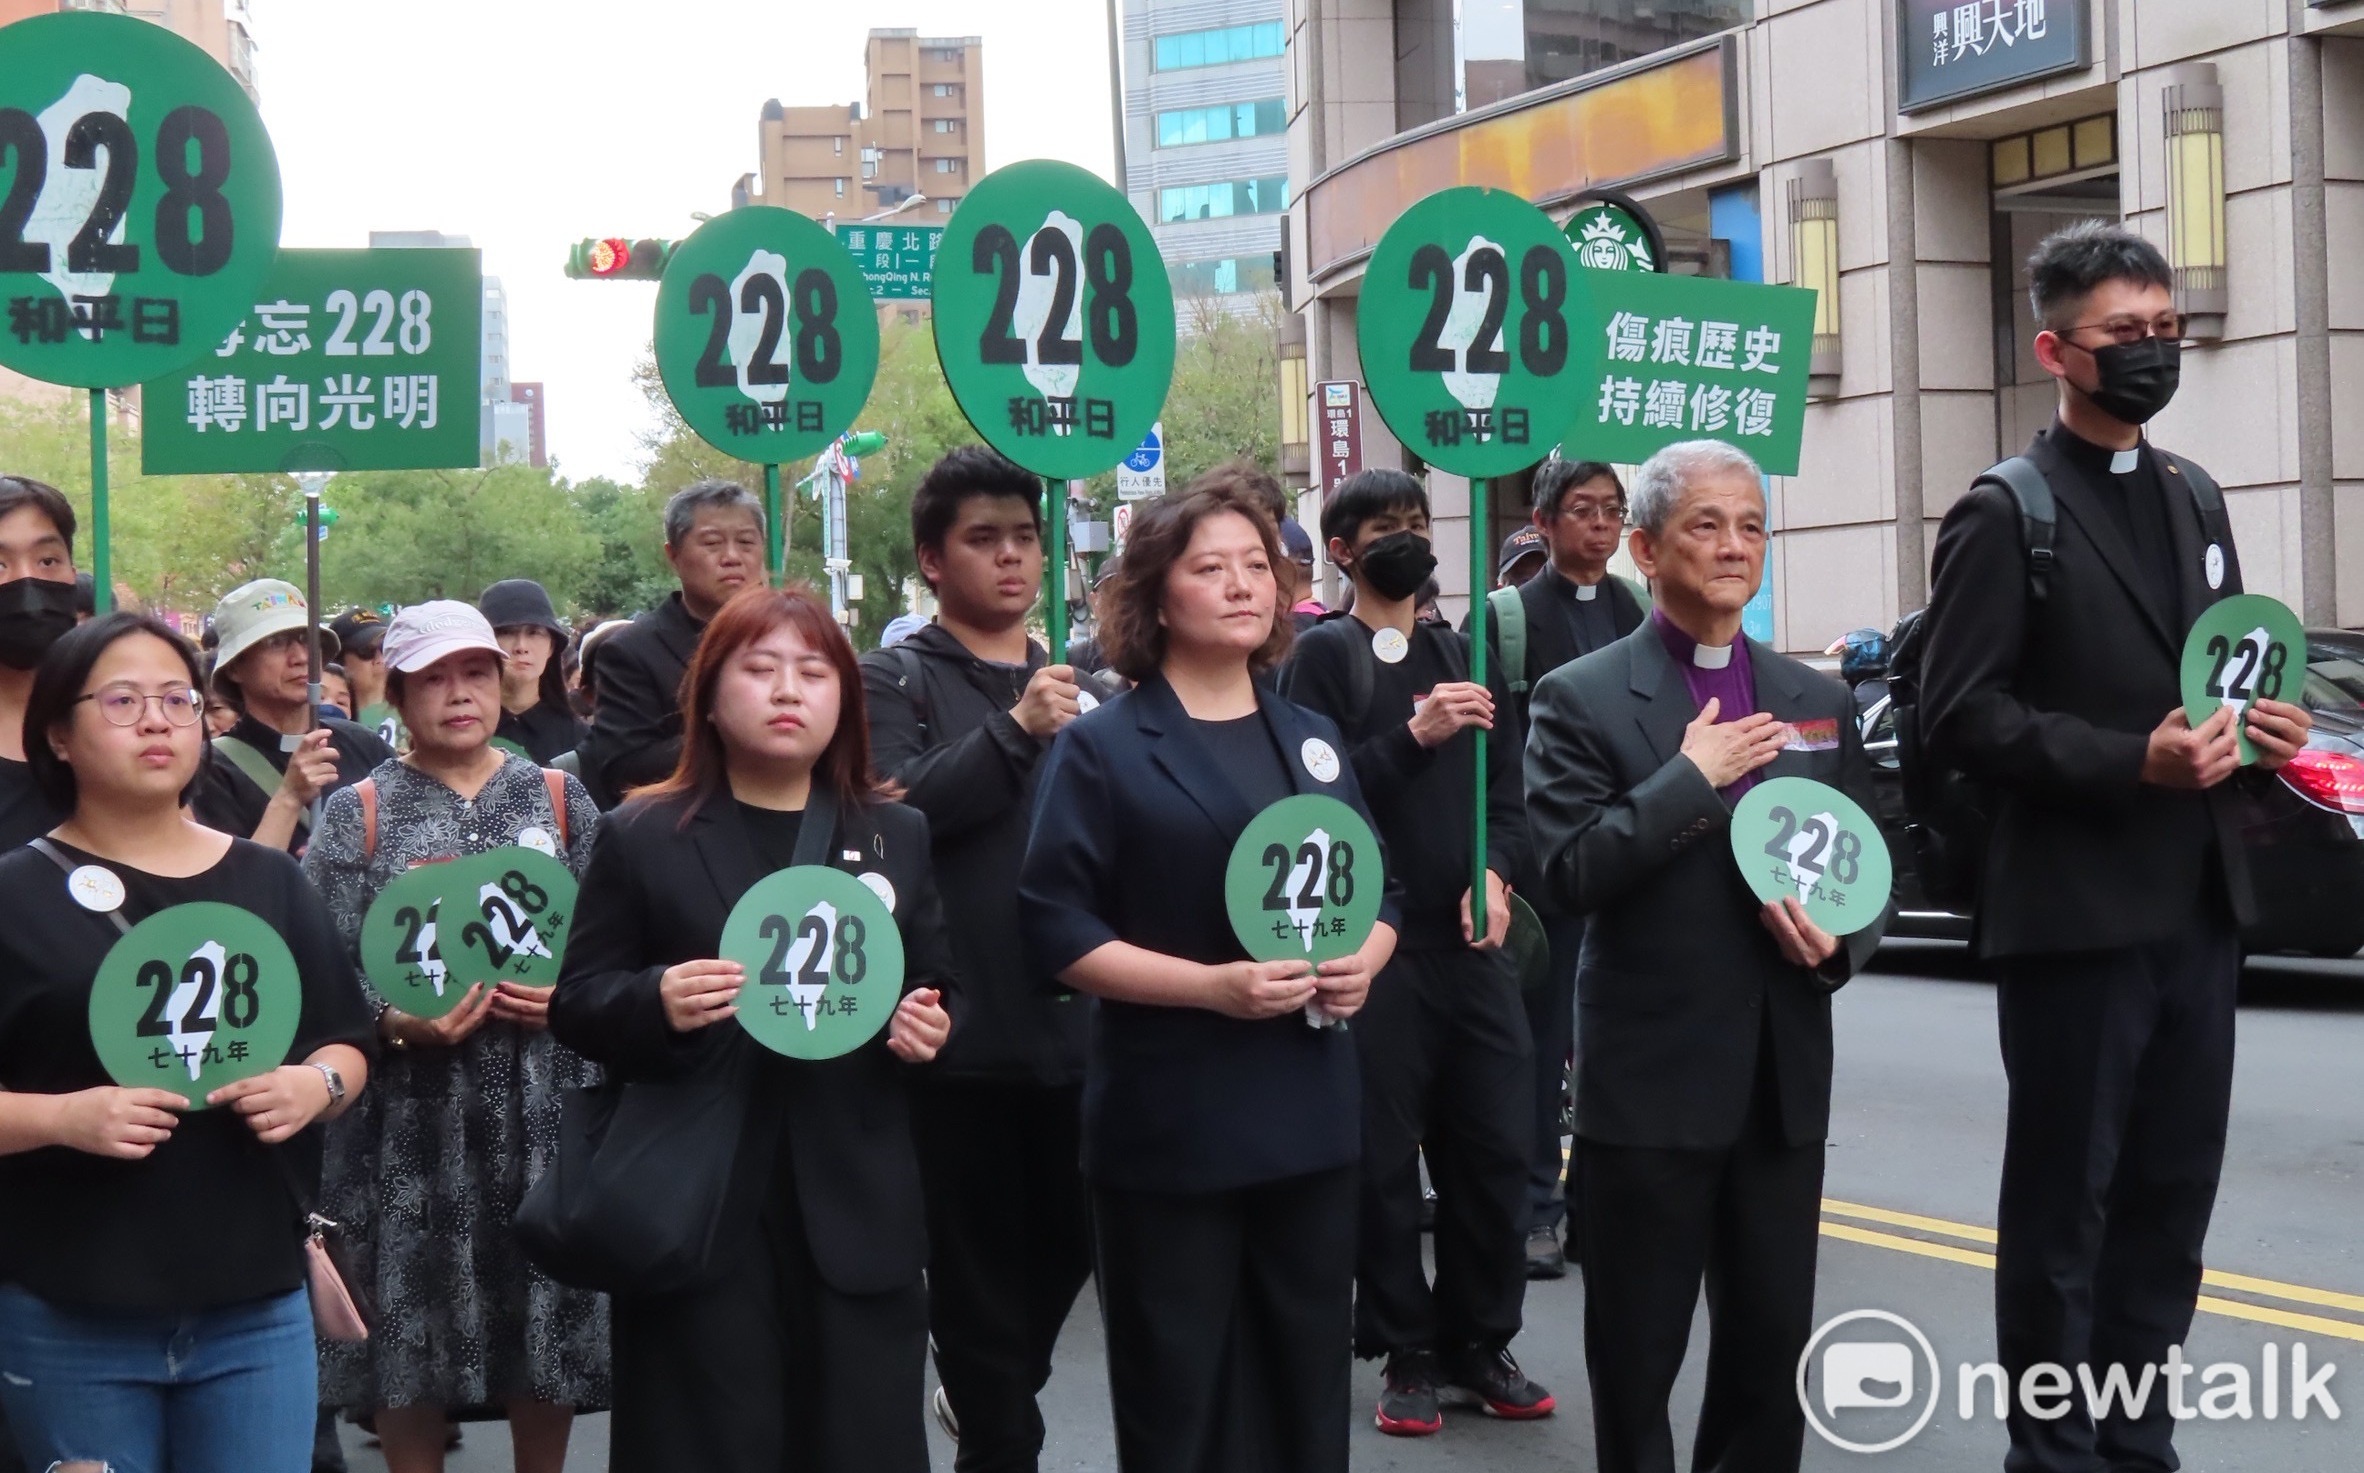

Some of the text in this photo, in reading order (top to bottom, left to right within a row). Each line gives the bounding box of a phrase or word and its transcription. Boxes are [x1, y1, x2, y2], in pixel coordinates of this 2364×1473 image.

[1933, 11, 1949, 67] 興洋
[0, 106, 234, 276] 228
[863, 271, 908, 284] hongQing
[972, 222, 1138, 367] 228
[8, 295, 181, 345] 和平日
[325, 289, 432, 356] 228
[689, 269, 842, 388] 228
[1408, 244, 1568, 378] 228
[1606, 311, 1781, 374] 傷痕歷史
[187, 374, 438, 432] 轉向光明
[725, 400, 824, 437] 和平日
[1008, 396, 1115, 440] 和平日
[1425, 408, 1531, 447] 和平日
[1598, 374, 1777, 437] 持續修復
[1120, 476, 1163, 487] 行人優先
[2206, 635, 2288, 700] 228
[1262, 841, 1354, 911] 228
[1764, 806, 1862, 886] 228
[1769, 866, 1847, 907] 七十九年
[462, 870, 548, 970] 228
[513, 910, 564, 974] 七十九年
[758, 915, 866, 985] 228
[1271, 918, 1346, 940] 七十九年
[136, 952, 260, 1037] 228
[769, 995, 858, 1017] 七十九年
[148, 1040, 250, 1070] 七十九年
